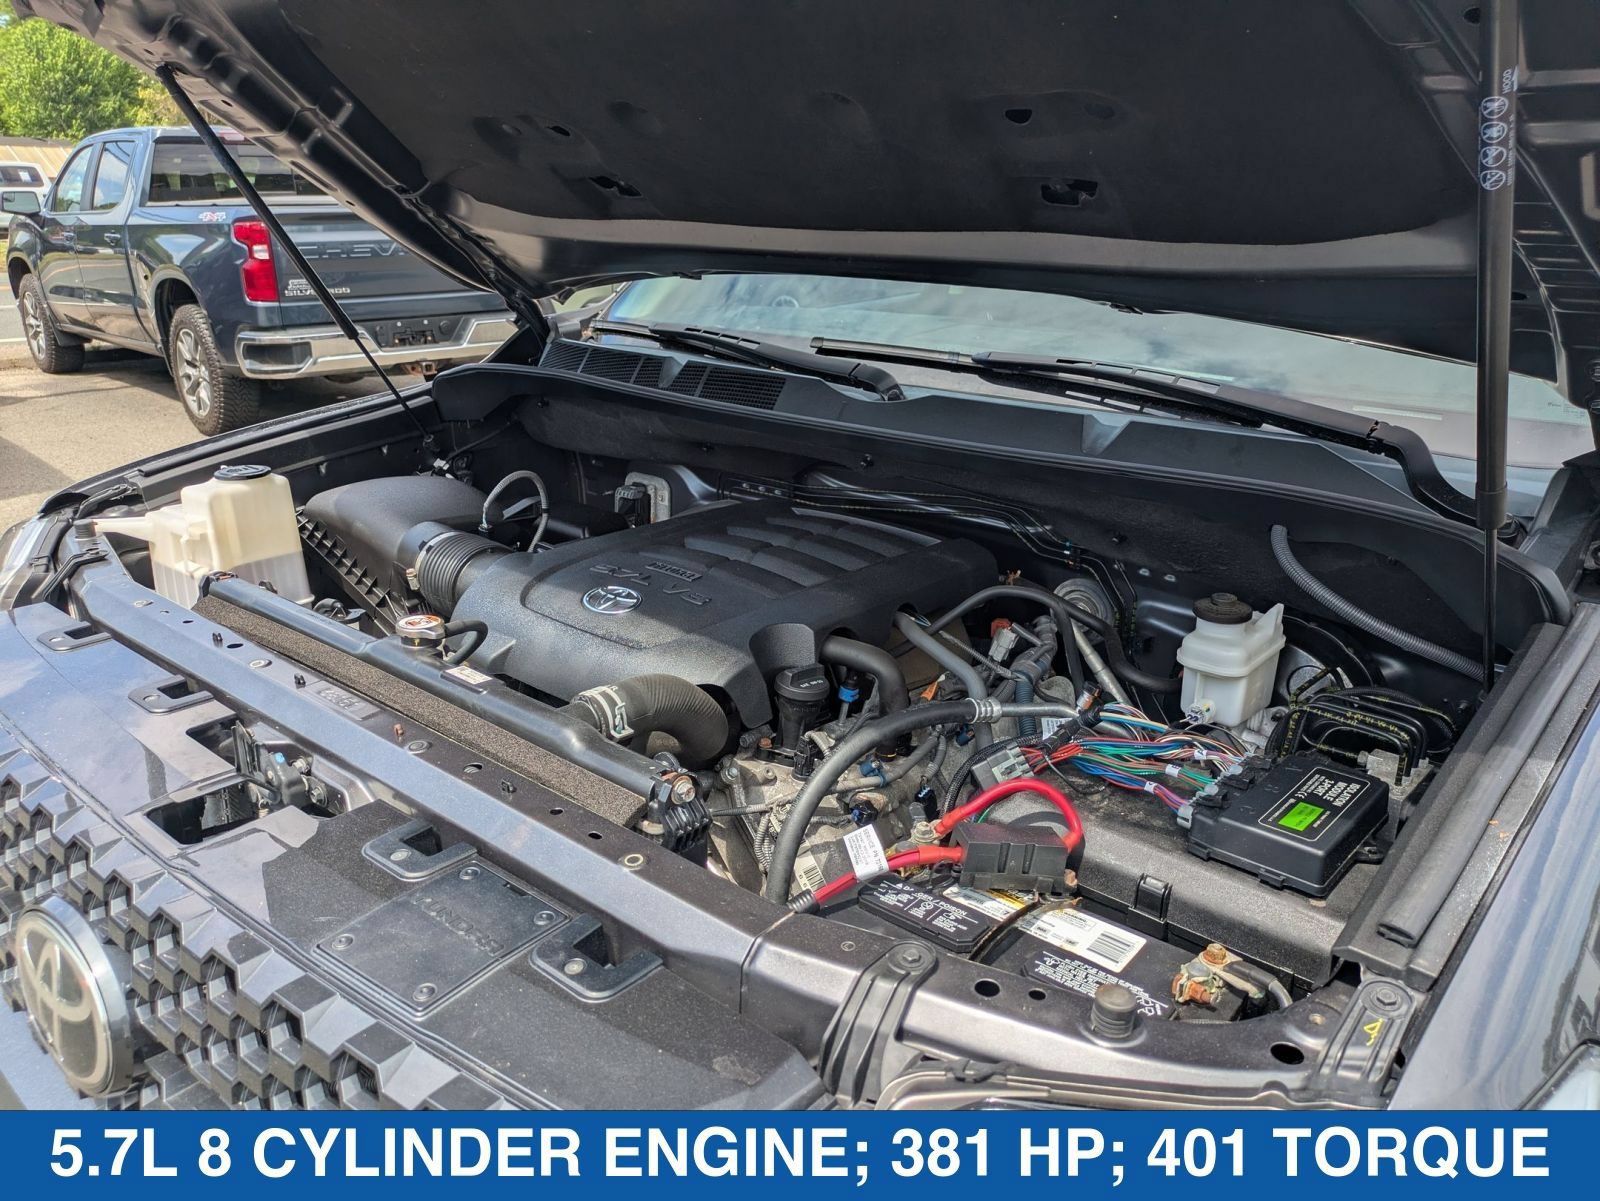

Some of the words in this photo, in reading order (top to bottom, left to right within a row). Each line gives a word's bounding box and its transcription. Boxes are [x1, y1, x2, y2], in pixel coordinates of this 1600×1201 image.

[1502, 69, 1513, 94] HOOD
[1323, 781, 1348, 801] MODULE
[1332, 782, 1361, 807] ISOLATION
[938, 901, 968, 916] POISON
